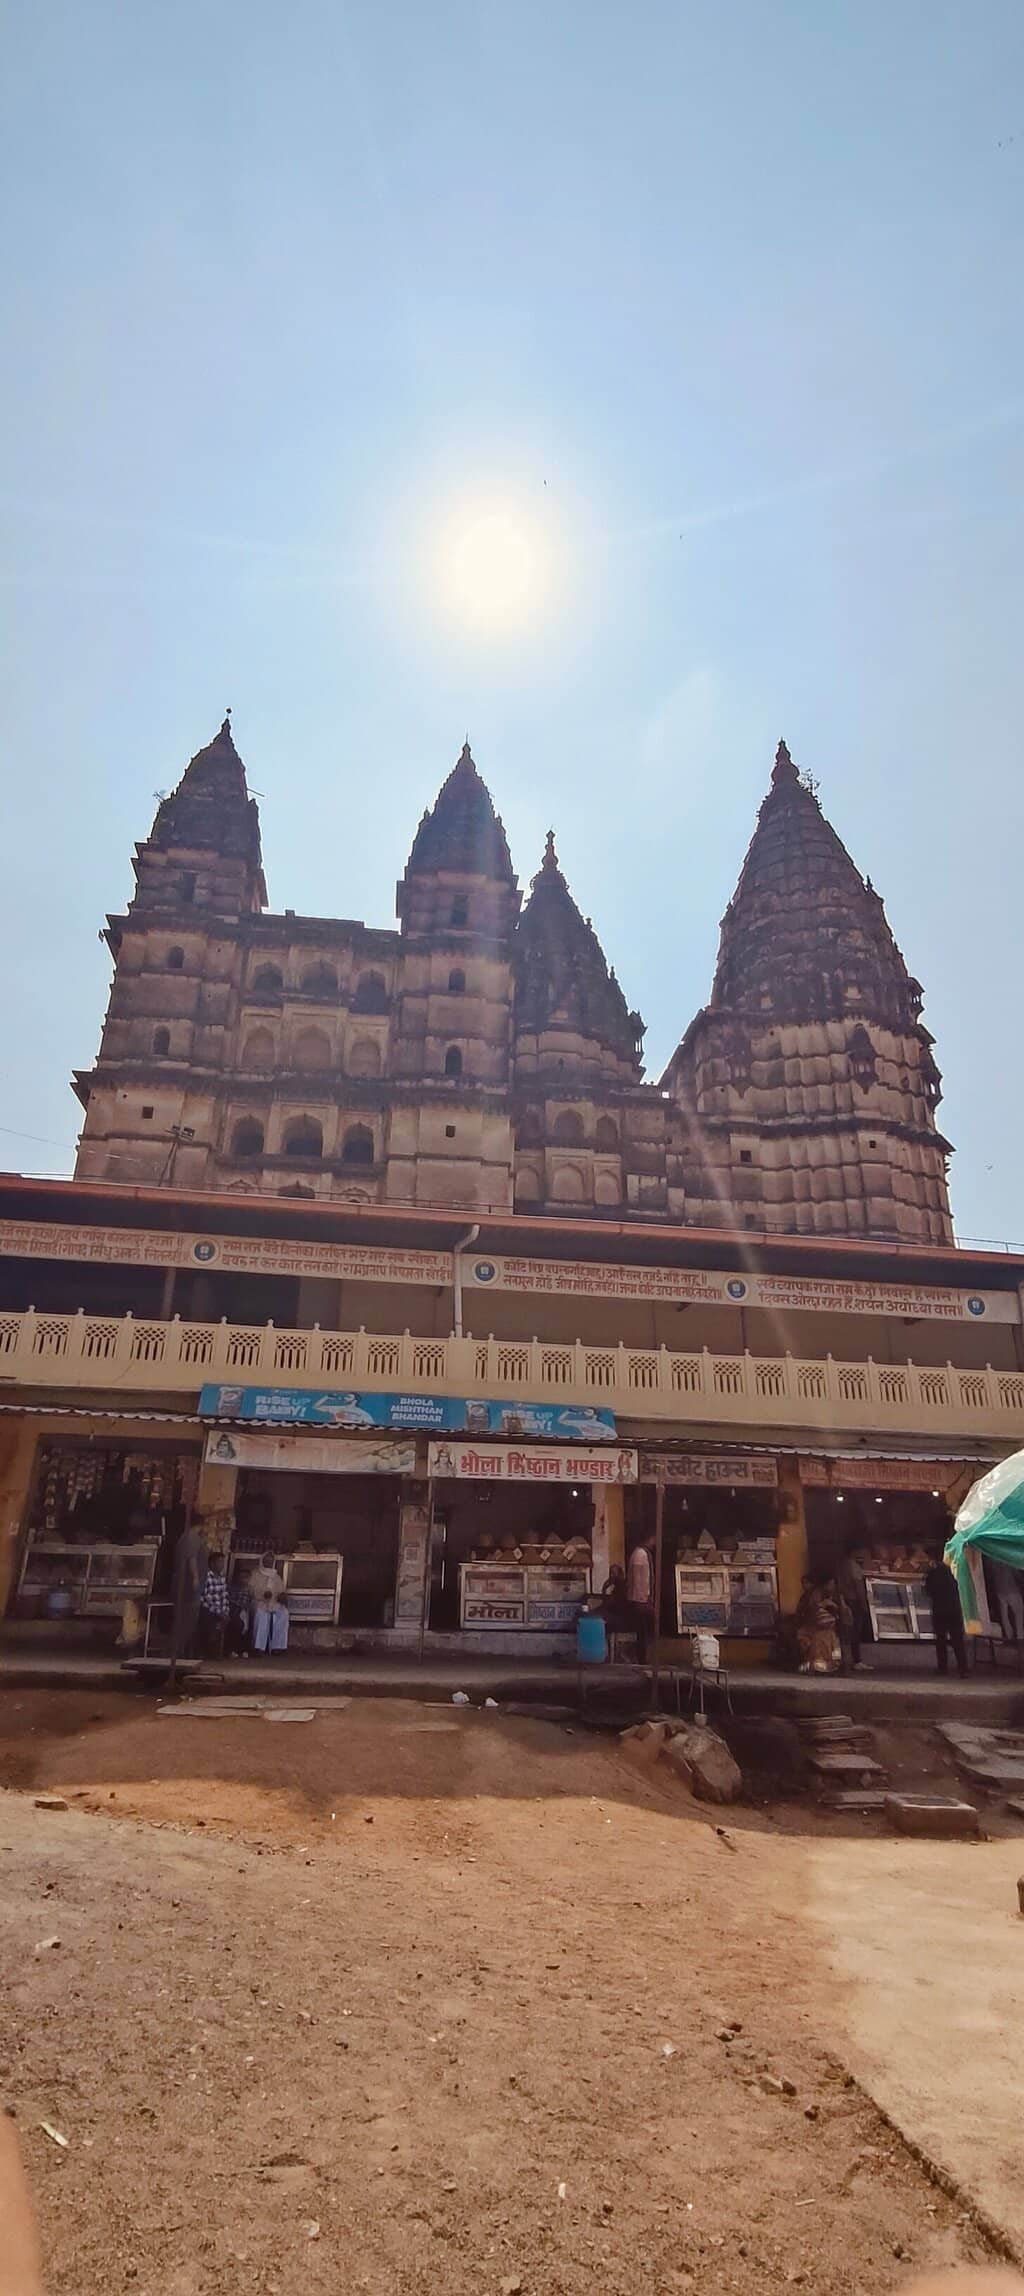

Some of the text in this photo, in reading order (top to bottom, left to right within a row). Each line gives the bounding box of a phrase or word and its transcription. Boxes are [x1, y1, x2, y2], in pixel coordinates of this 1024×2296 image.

[255, 1395, 311, 1407] RISE UP
[399, 1397, 434, 1407] BHOLA
[390, 1405, 444, 1415] MISHTHAN
[536, 1411, 554, 1420] UP
[391, 1413, 443, 1423] BHANDAR
[459, 1449, 502, 1476] भोला
[566, 1458, 616, 1480] भण्डार
[666, 1455, 703, 1477] स्वीट
[468, 1600, 521, 1620] भोला
